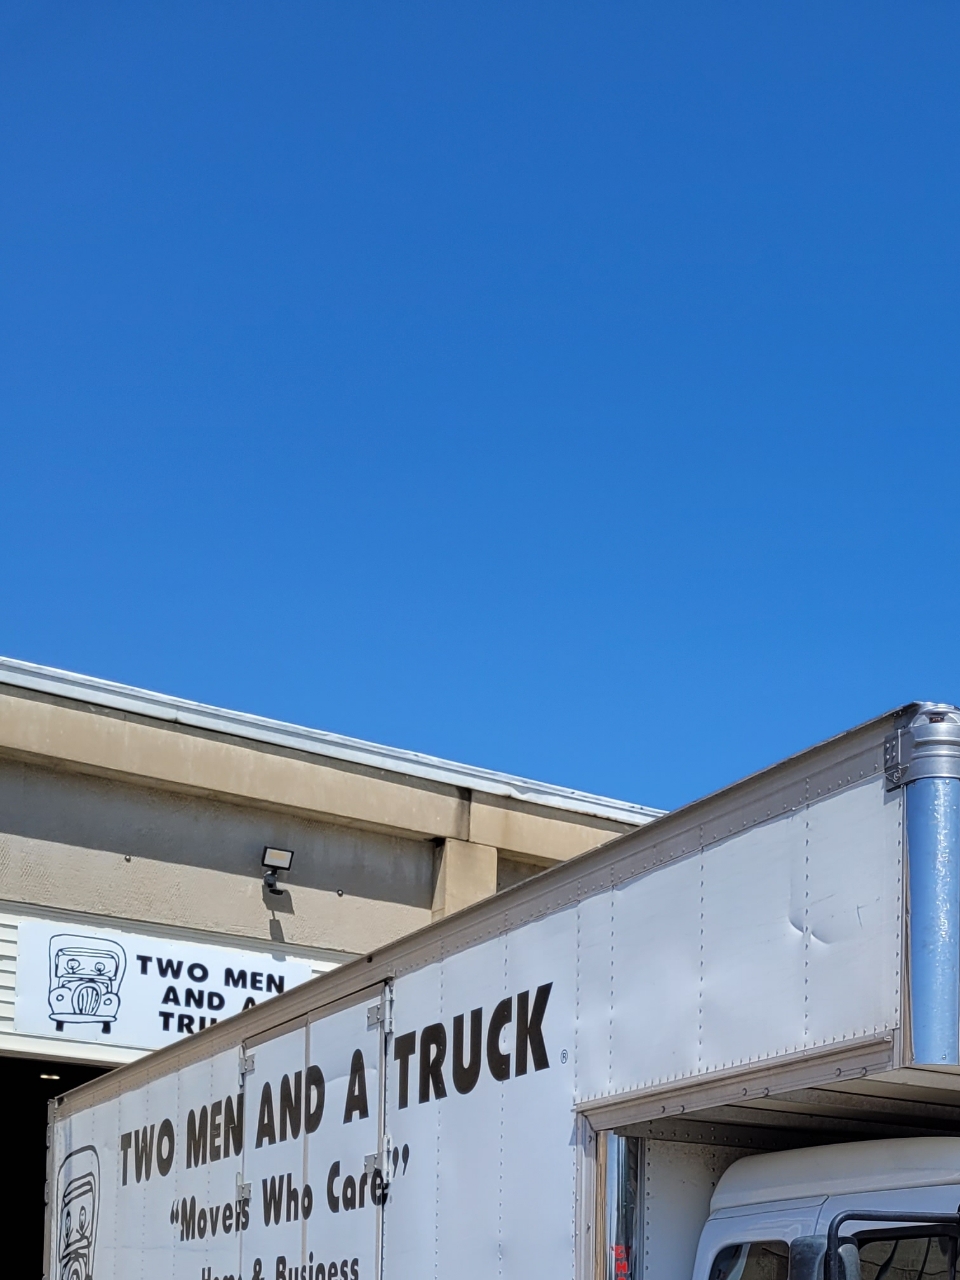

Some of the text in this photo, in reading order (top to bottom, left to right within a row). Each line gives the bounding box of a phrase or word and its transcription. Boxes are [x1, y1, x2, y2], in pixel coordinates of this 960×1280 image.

[136, 954, 285, 994] TWO MEN
[161, 986, 225, 1011] AND
[120, 982, 553, 1186] TWO MEN AND A TRUCK
[262, 1173, 313, 1227] Who
